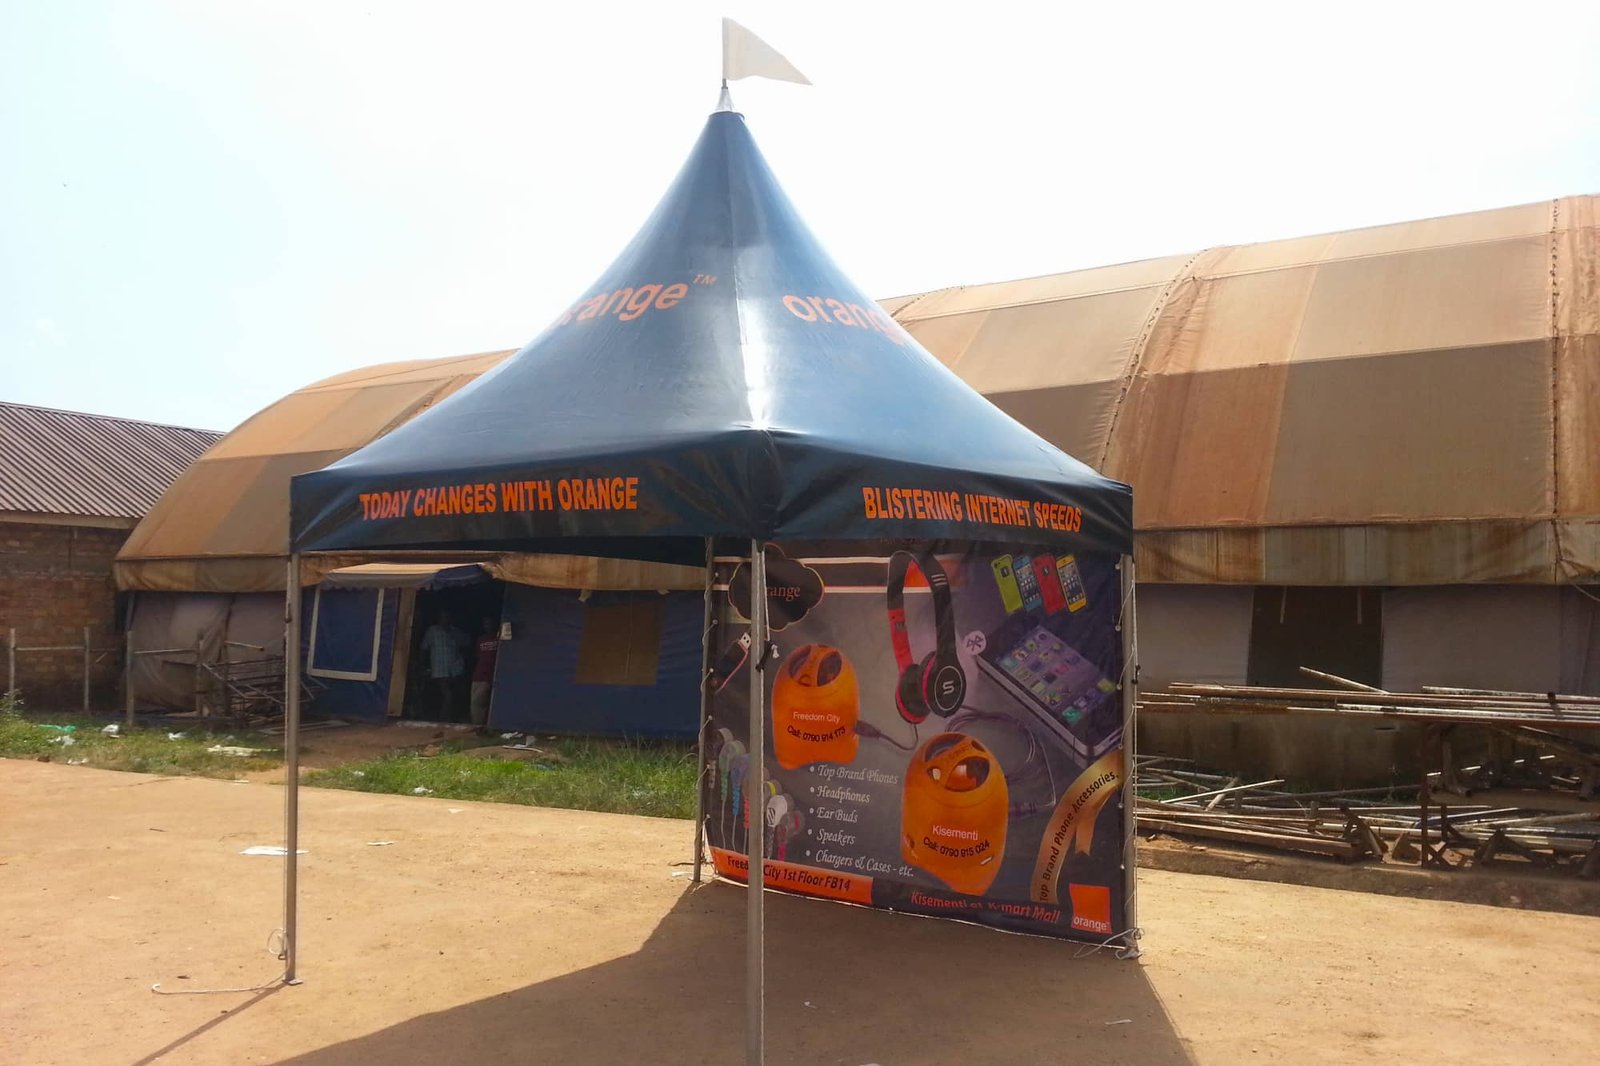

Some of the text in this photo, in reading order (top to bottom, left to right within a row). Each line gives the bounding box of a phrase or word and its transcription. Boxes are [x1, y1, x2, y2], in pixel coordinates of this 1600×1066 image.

[560, 282, 688, 326] range
[359, 477, 639, 521] TODAY CHANGES WITH ORANGE
[862, 487, 1082, 533] BLISTERING INTERNET SPEEDS
[767, 586, 801, 602] range
[792, 711, 840, 725] Freedom City
[803, 732, 820, 742] 0790
[817, 764, 899, 785] Top Brand Phones
[816, 785, 870, 804] Headphones
[816, 807, 858, 823] Ear Buds
[816, 829, 855, 846] Speakers
[932, 825, 978, 841] Kisementi
[940, 845, 959, 857] 0790
[1042, 847, 1059, 880] Brand
[1057, 812, 1074, 846] Phone
[816, 850, 853, 869] Chargers
[867, 859, 891, 873] Cases
[899, 866, 914, 878] etc.
[763, 865, 780, 881] City
[783, 868, 798, 883] 1st
[798, 871, 823, 888] Floor
[825, 875, 851, 892] FB14
[1032, 907, 1062, 924] Mall
[1073, 916, 1107, 933] orange
